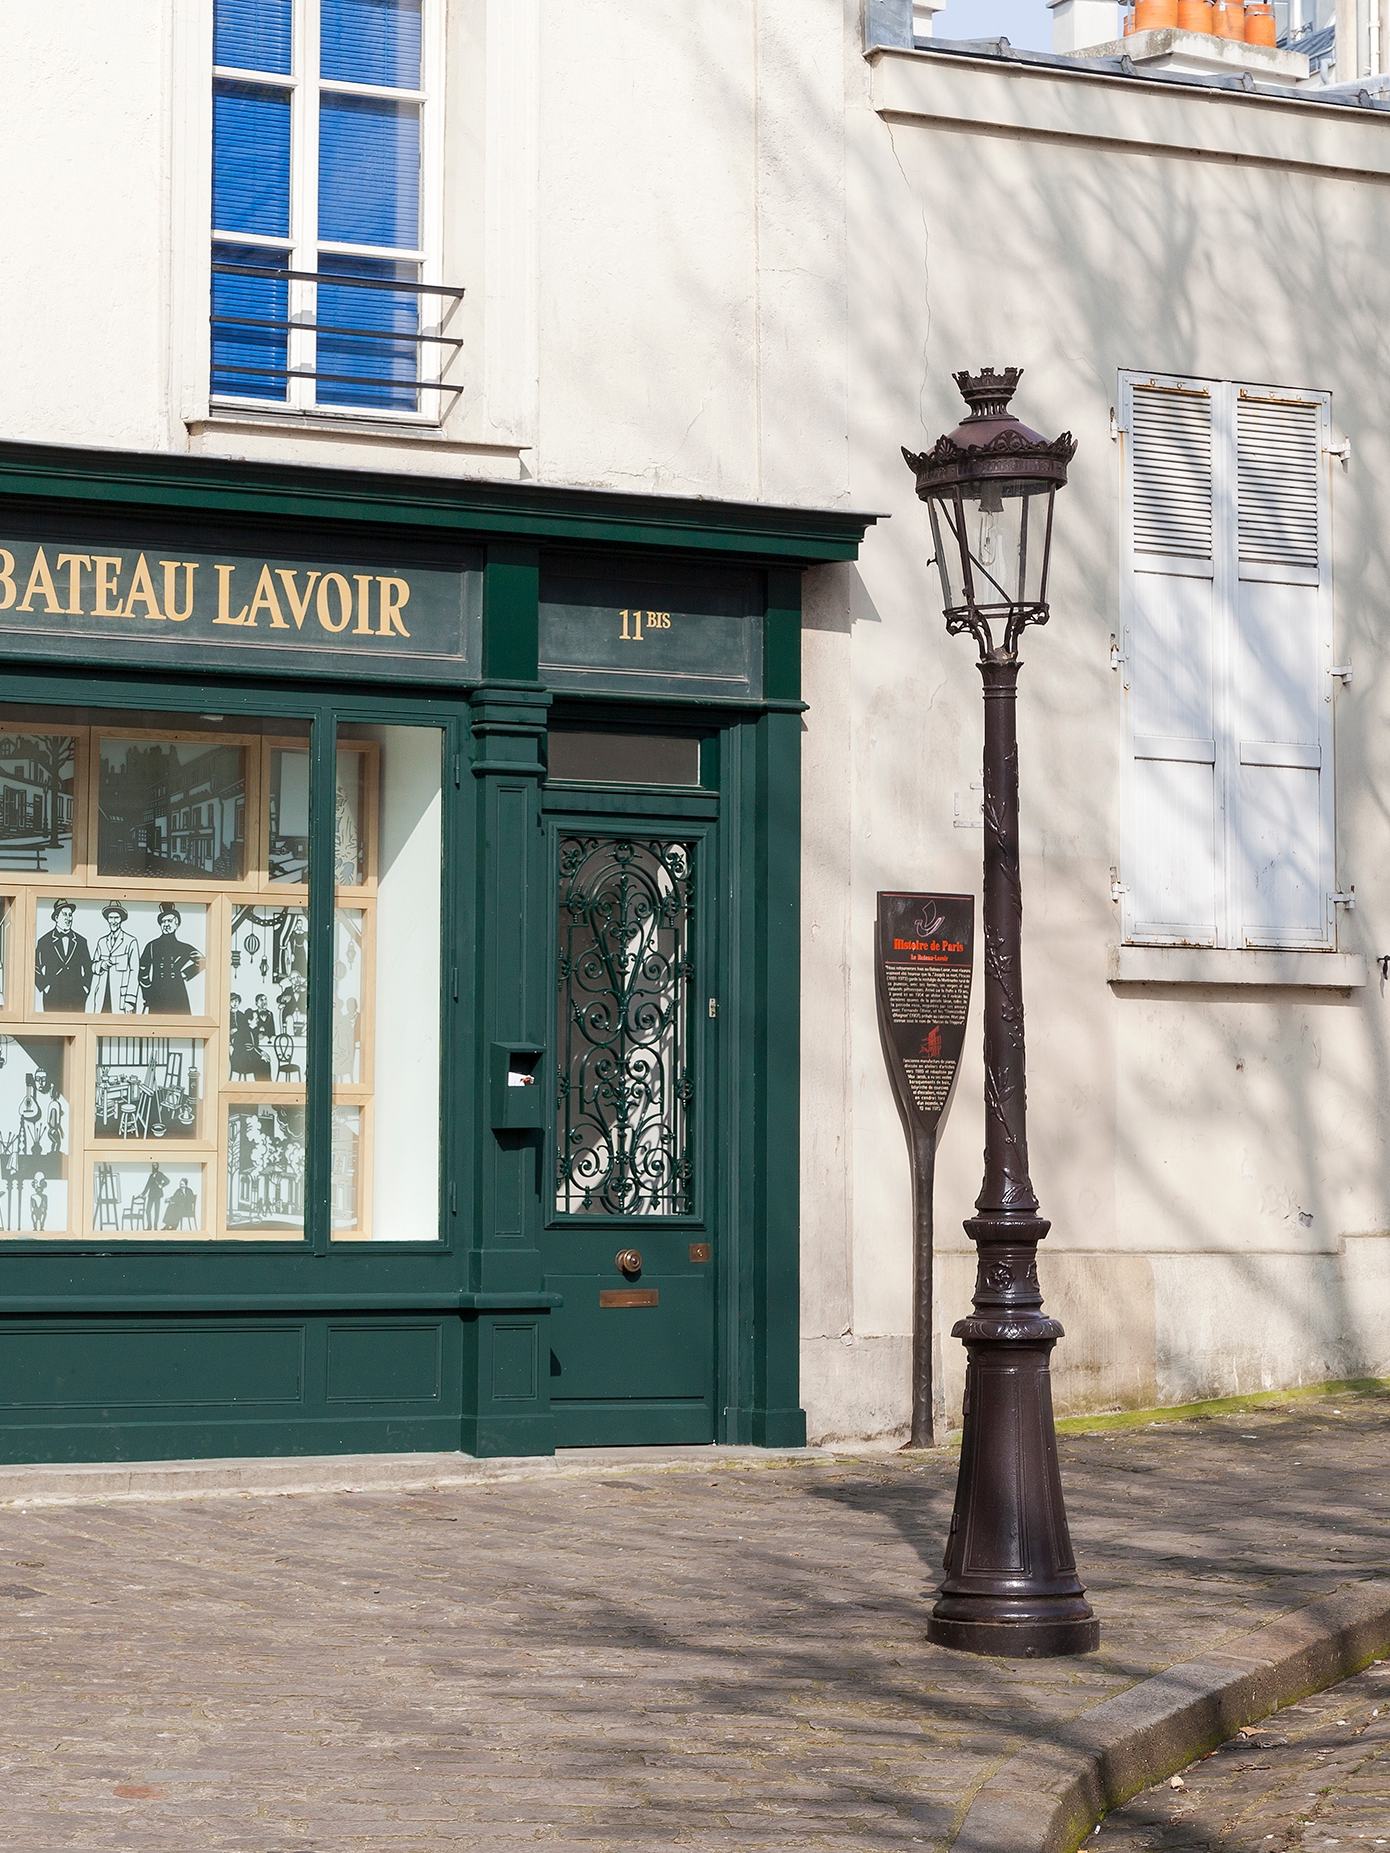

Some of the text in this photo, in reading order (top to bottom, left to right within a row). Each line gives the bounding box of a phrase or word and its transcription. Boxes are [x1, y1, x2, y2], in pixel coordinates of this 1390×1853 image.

[212, 563, 411, 638] LAVOIR
[619, 609, 671, 641] 11 BIS
[893, 938, 964, 952] Histoire de Paris
